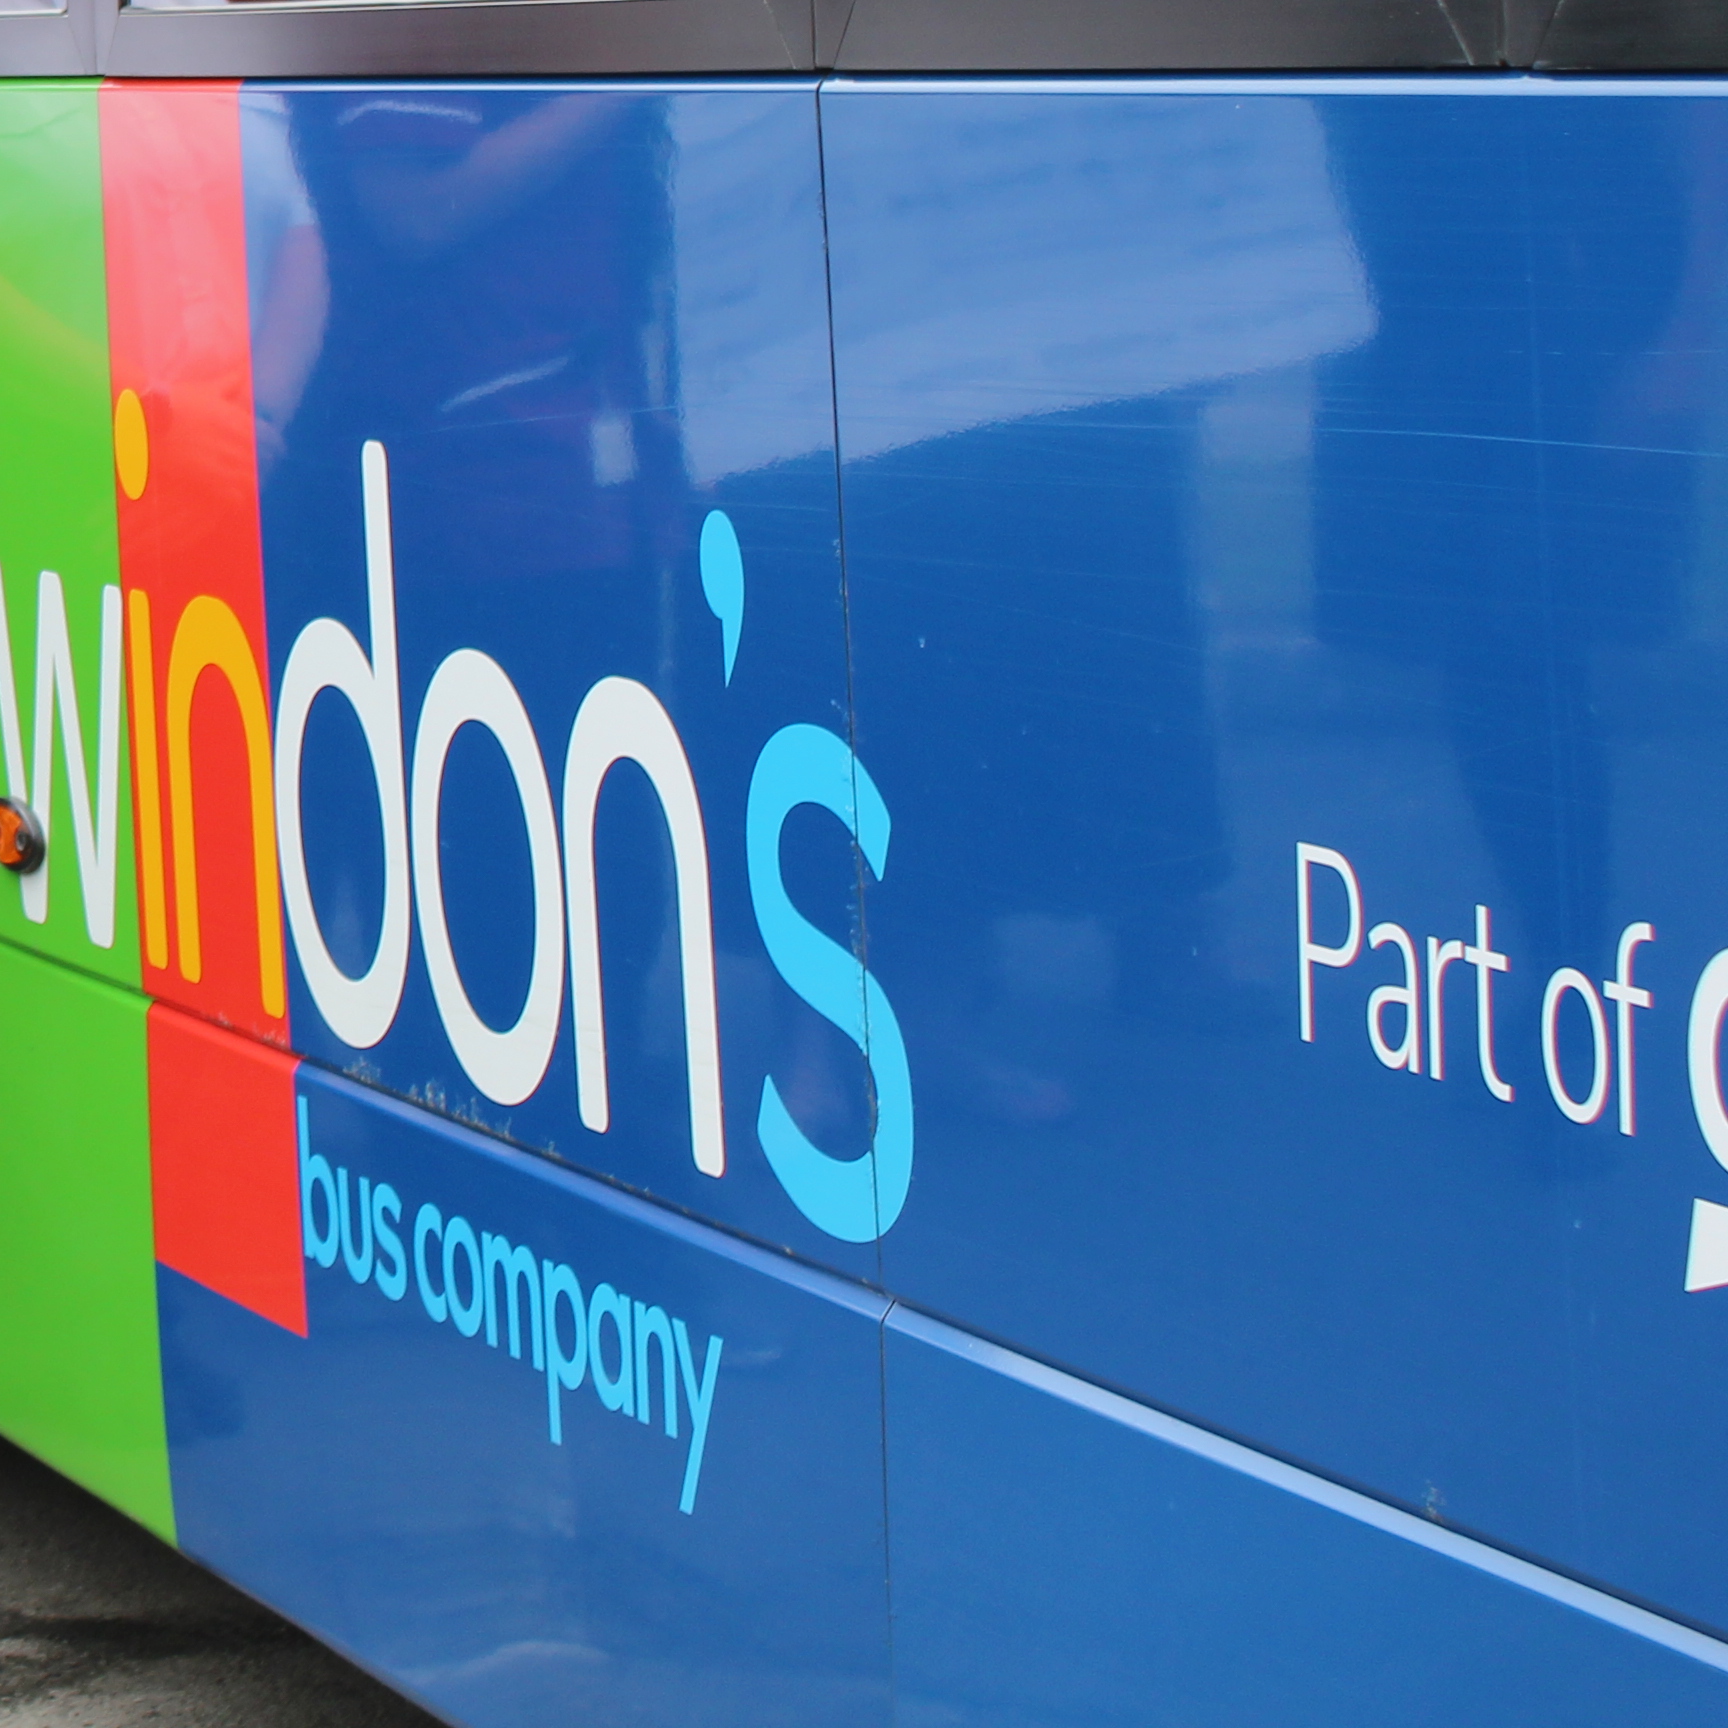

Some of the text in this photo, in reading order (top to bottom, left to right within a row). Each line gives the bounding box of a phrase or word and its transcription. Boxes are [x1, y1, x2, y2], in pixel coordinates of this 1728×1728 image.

[1295, 840, 1516, 1103] Part
[1540, 920, 1656, 1138] of
[297, 1094, 724, 1515] bus company
